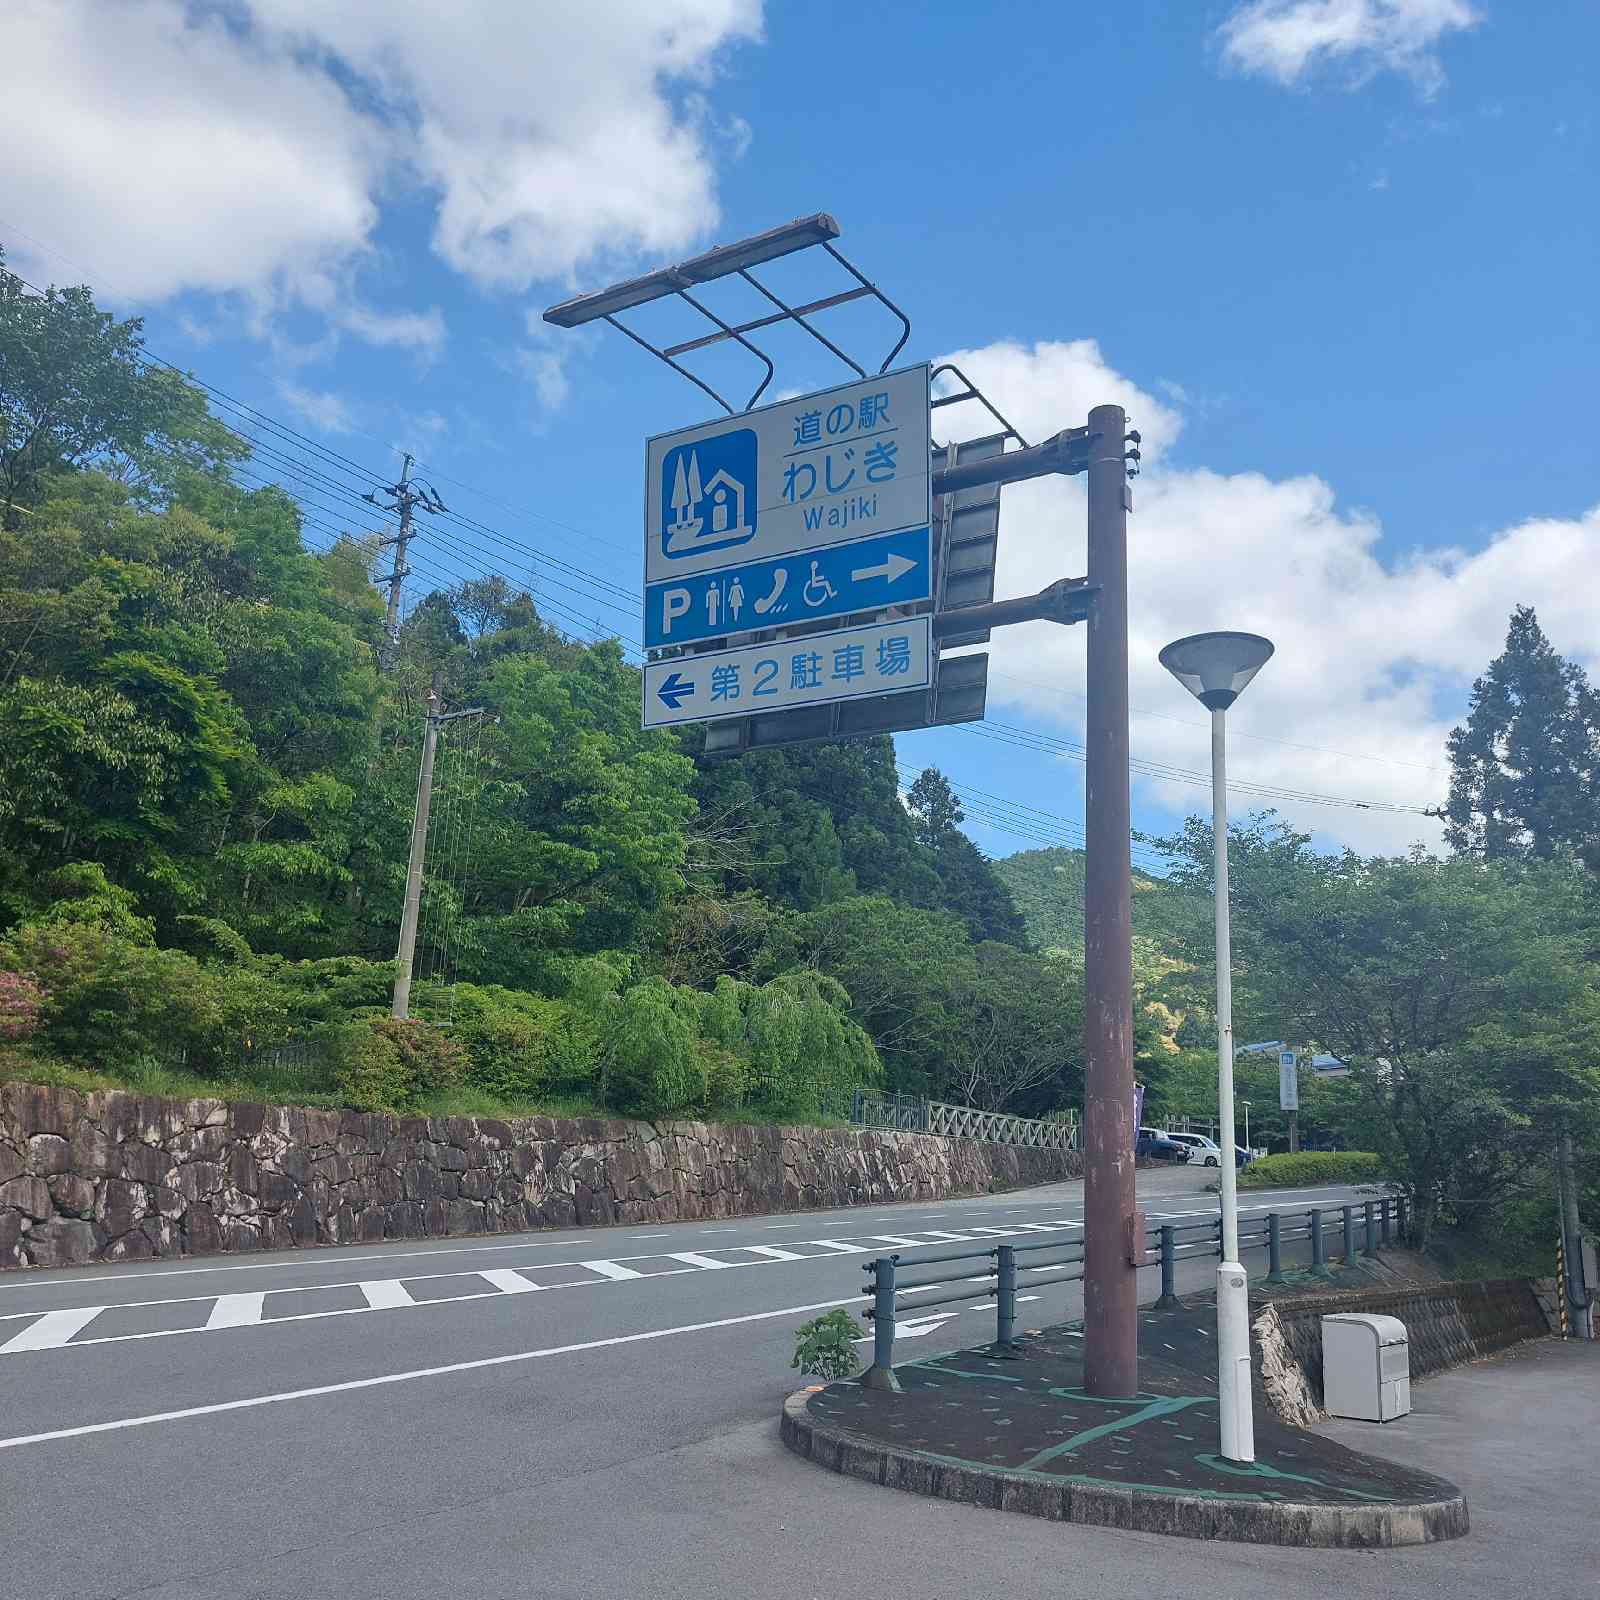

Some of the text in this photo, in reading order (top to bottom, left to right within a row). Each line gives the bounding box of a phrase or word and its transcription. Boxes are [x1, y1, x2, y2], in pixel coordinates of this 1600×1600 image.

[793, 392, 890, 446] 道の駅
[782, 440, 898, 504] わじき
[802, 493, 880, 531] Wajiki
[662, 588, 691, 634] P
[710, 636, 911, 702] 第2駐車場
